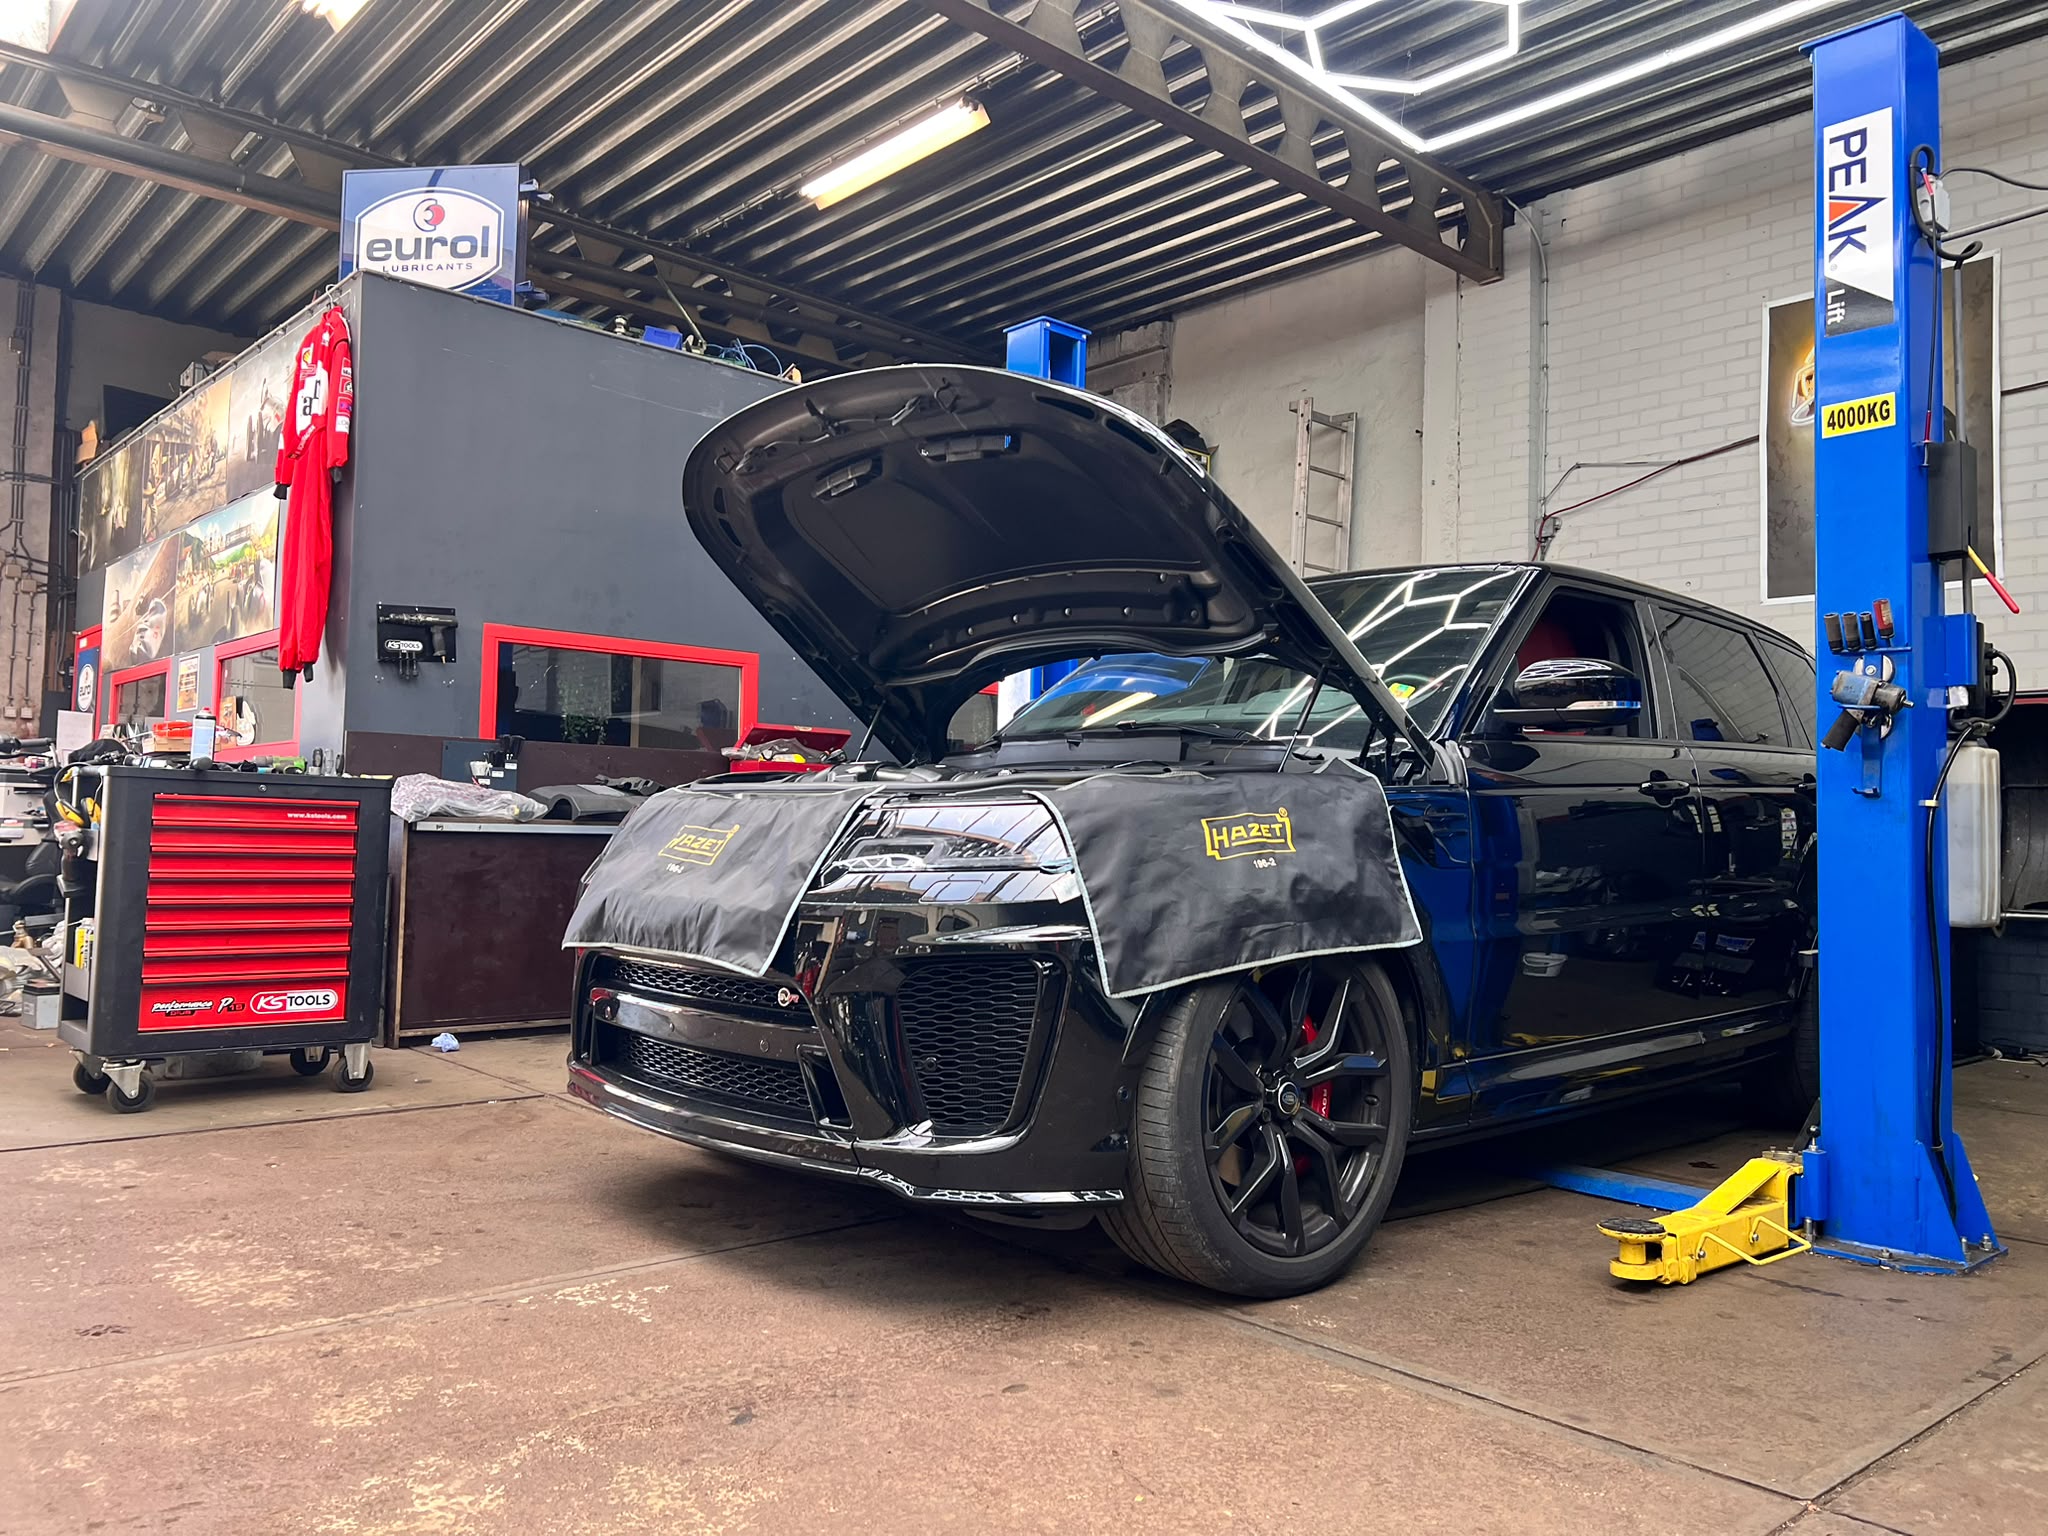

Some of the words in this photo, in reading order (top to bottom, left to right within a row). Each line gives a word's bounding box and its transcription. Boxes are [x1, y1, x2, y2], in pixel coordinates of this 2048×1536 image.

[1828, 127, 1888, 263] PEAK
[366, 226, 490, 262] eurol
[382, 262, 473, 273] LUBRICANTS
[1827, 289, 1846, 326] Lift
[1827, 400, 1890, 430] 4000KG
[1212, 823, 1283, 849] HAZET
[287, 994, 330, 1007] TOOLS
